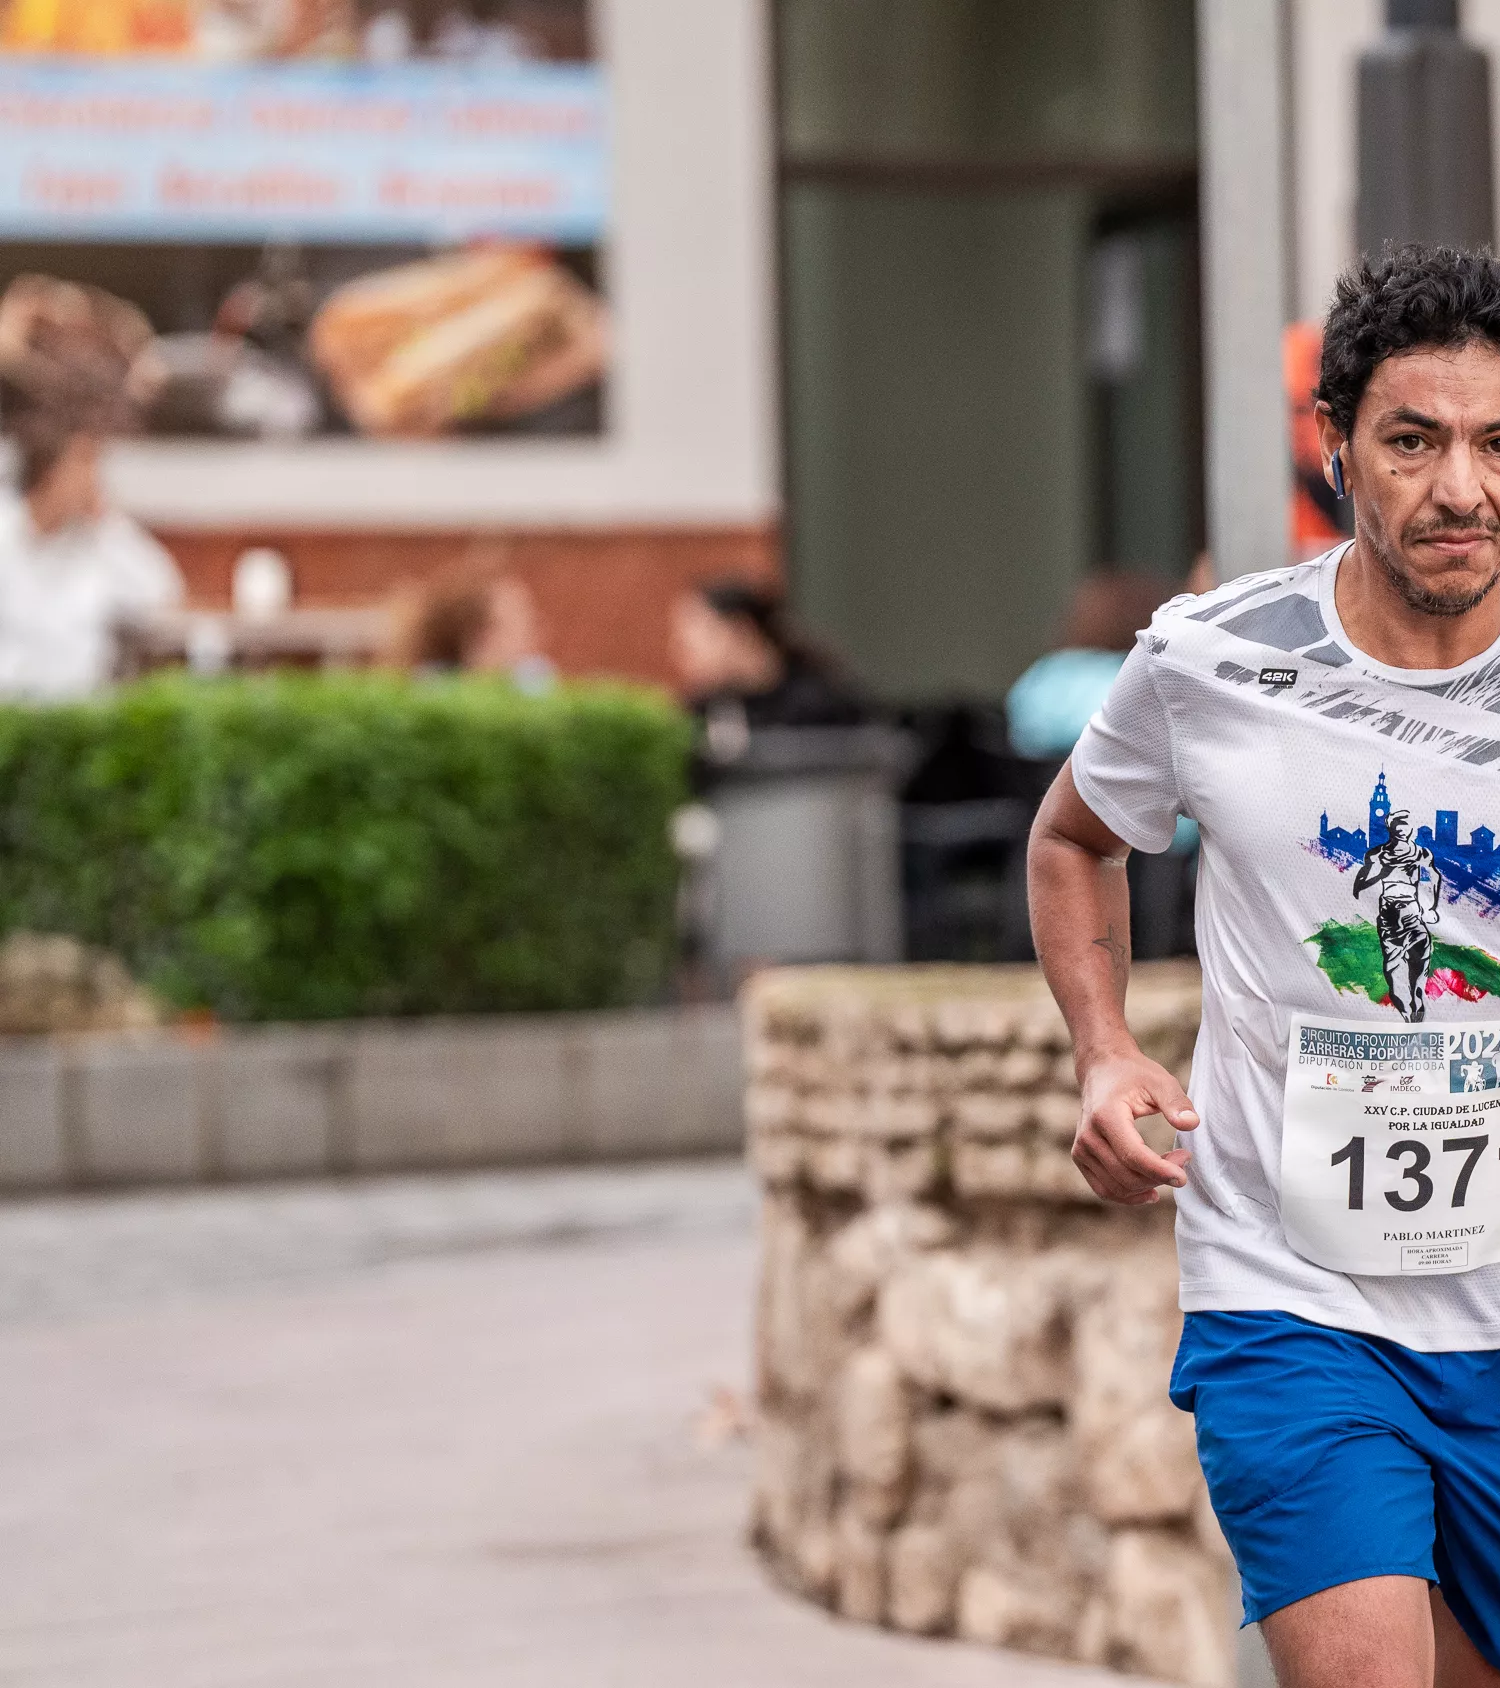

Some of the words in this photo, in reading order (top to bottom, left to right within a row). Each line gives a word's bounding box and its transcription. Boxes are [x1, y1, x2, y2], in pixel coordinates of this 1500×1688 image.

[1261, 671, 1295, 682] 42K
[1300, 1027, 1350, 1045] CIRCUITO
[1354, 1034, 1425, 1047] PROVINCIAL
[1429, 1034, 1444, 1047] DE
[1300, 1041, 1364, 1059] CARRERAS
[1369, 1046, 1445, 1060] POPULARES
[1299, 1055, 1363, 1070] DIPUTACIÓN
[1370, 1062, 1384, 1071] DE
[1391, 1060, 1445, 1071] CÓRDOBA
[1364, 1105, 1388, 1116] XXV
[1390, 1106, 1410, 1116] C.P.
[1412, 1106, 1453, 1116] CIUDAD
[1455, 1105, 1470, 1114] DE
[1388, 1122, 1410, 1131] POR
[1412, 1122, 1428, 1131] LA
[1431, 1117, 1485, 1130] IGUALDAD
[1383, 1231, 1423, 1241] PABLO
[1426, 1224, 1486, 1240] MARTINEZ
